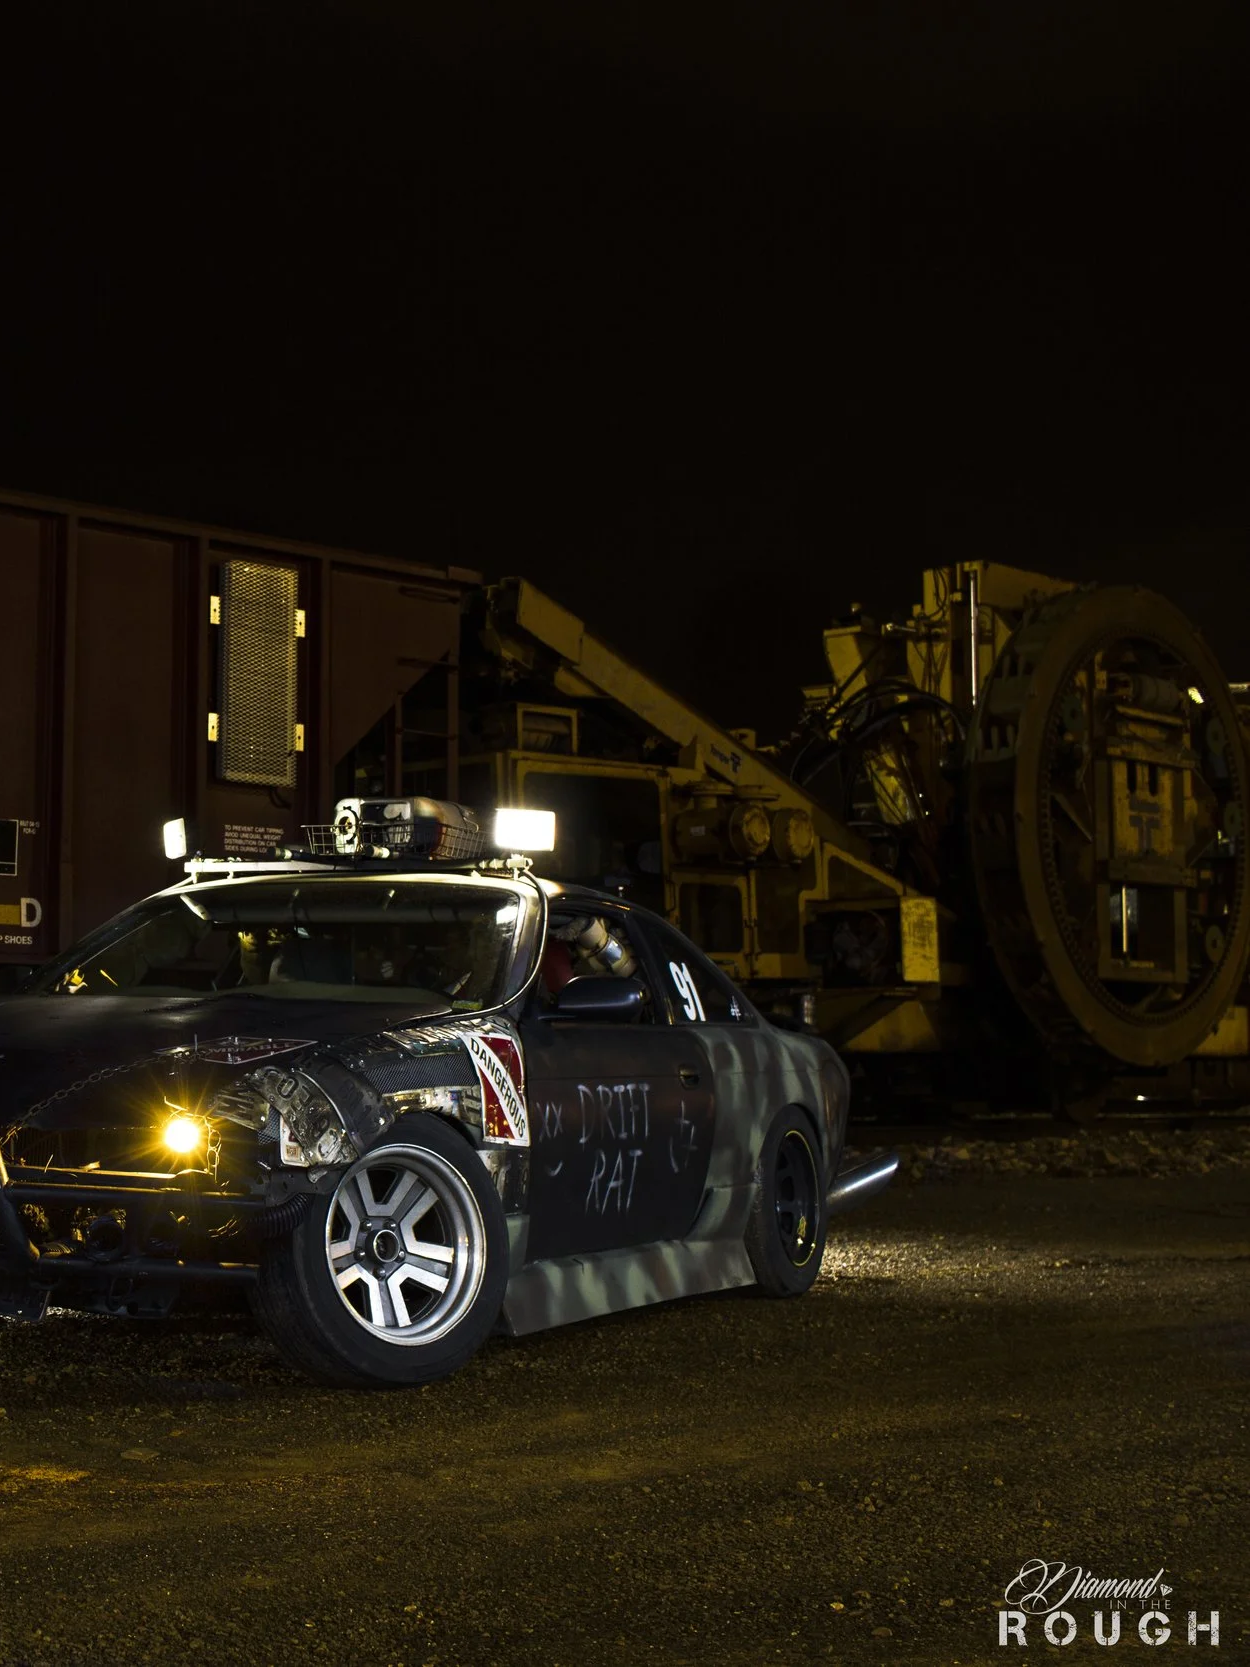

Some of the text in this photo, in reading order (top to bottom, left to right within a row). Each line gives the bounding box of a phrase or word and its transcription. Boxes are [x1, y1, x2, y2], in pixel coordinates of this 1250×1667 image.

[4, 935, 33, 945] SHOES
[20, 897, 42, 928] D
[669, 961, 706, 1022] 91
[469, 1036, 527, 1139] DANGEROUS
[576, 1083, 651, 1150] DRIFT
[584, 1149, 643, 1217] RAT
